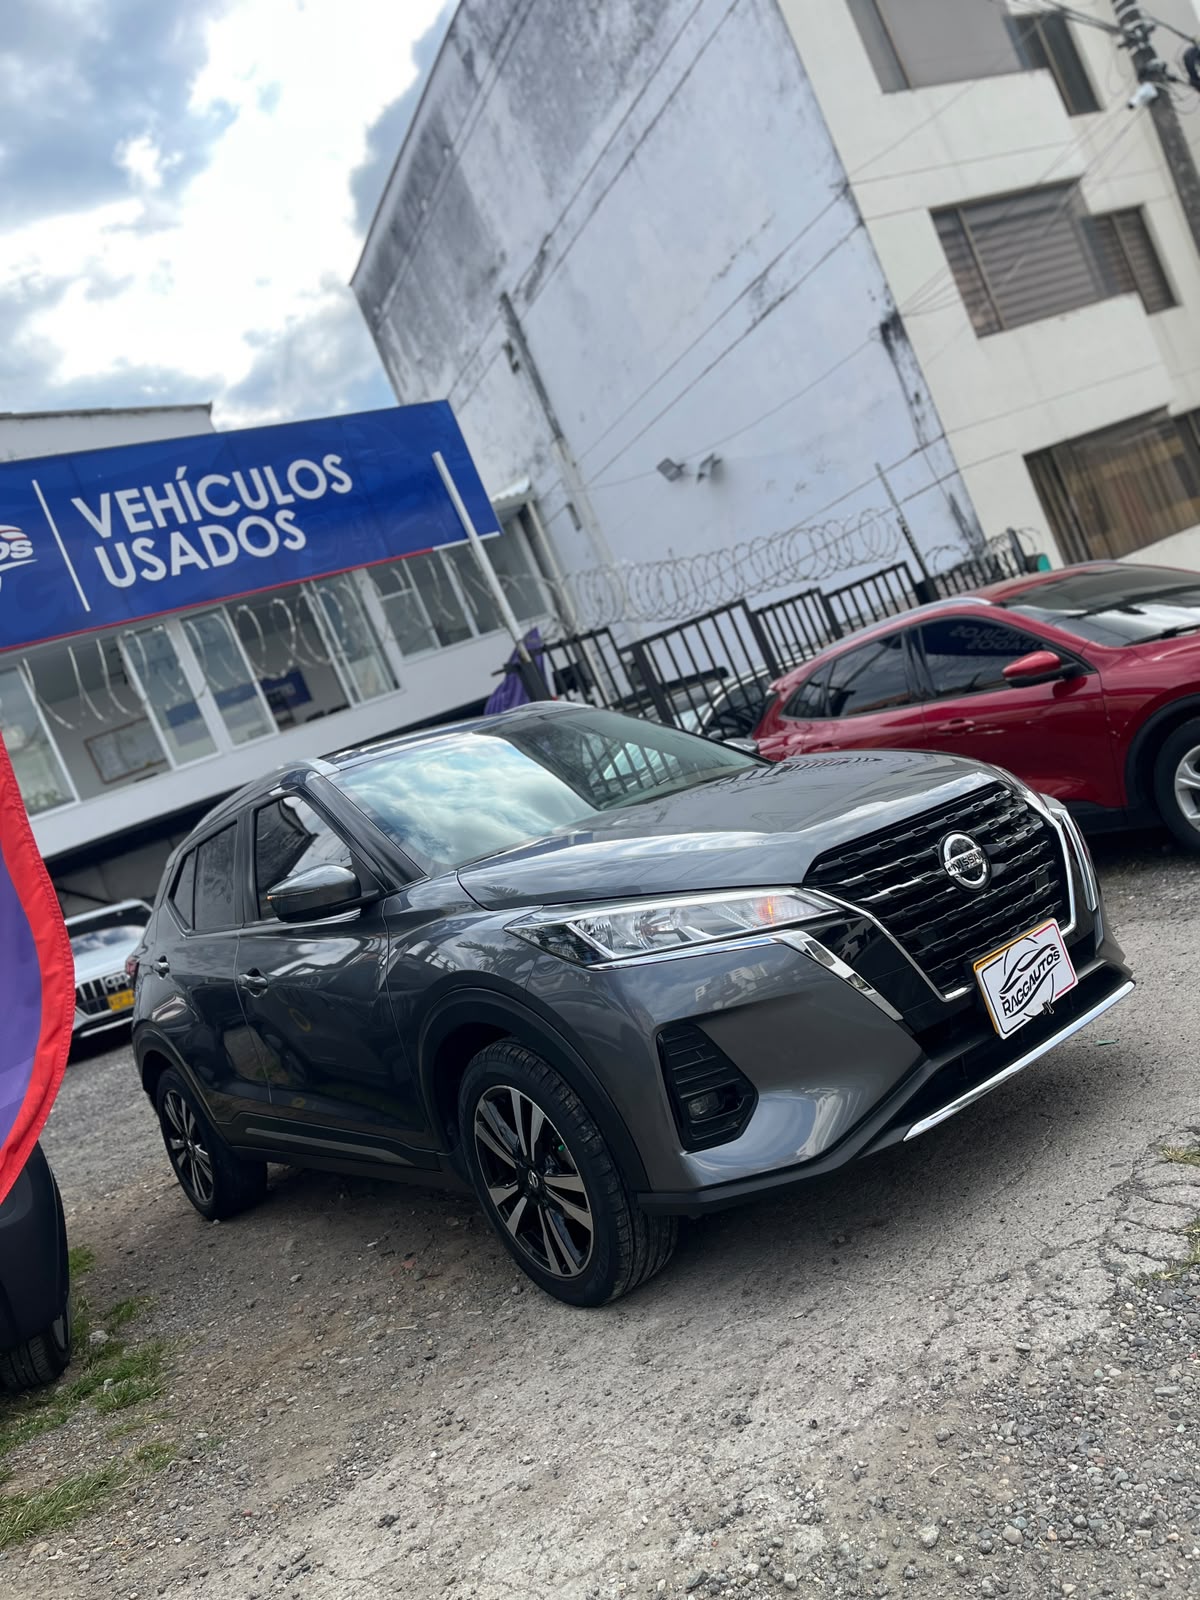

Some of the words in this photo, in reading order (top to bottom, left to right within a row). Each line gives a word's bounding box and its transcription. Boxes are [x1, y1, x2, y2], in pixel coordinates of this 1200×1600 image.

[71, 454, 353, 539] VEHÍCULOS
[94, 509, 307, 588] USADOS
[1002, 950, 1060, 1016] RAGGAUTOS
